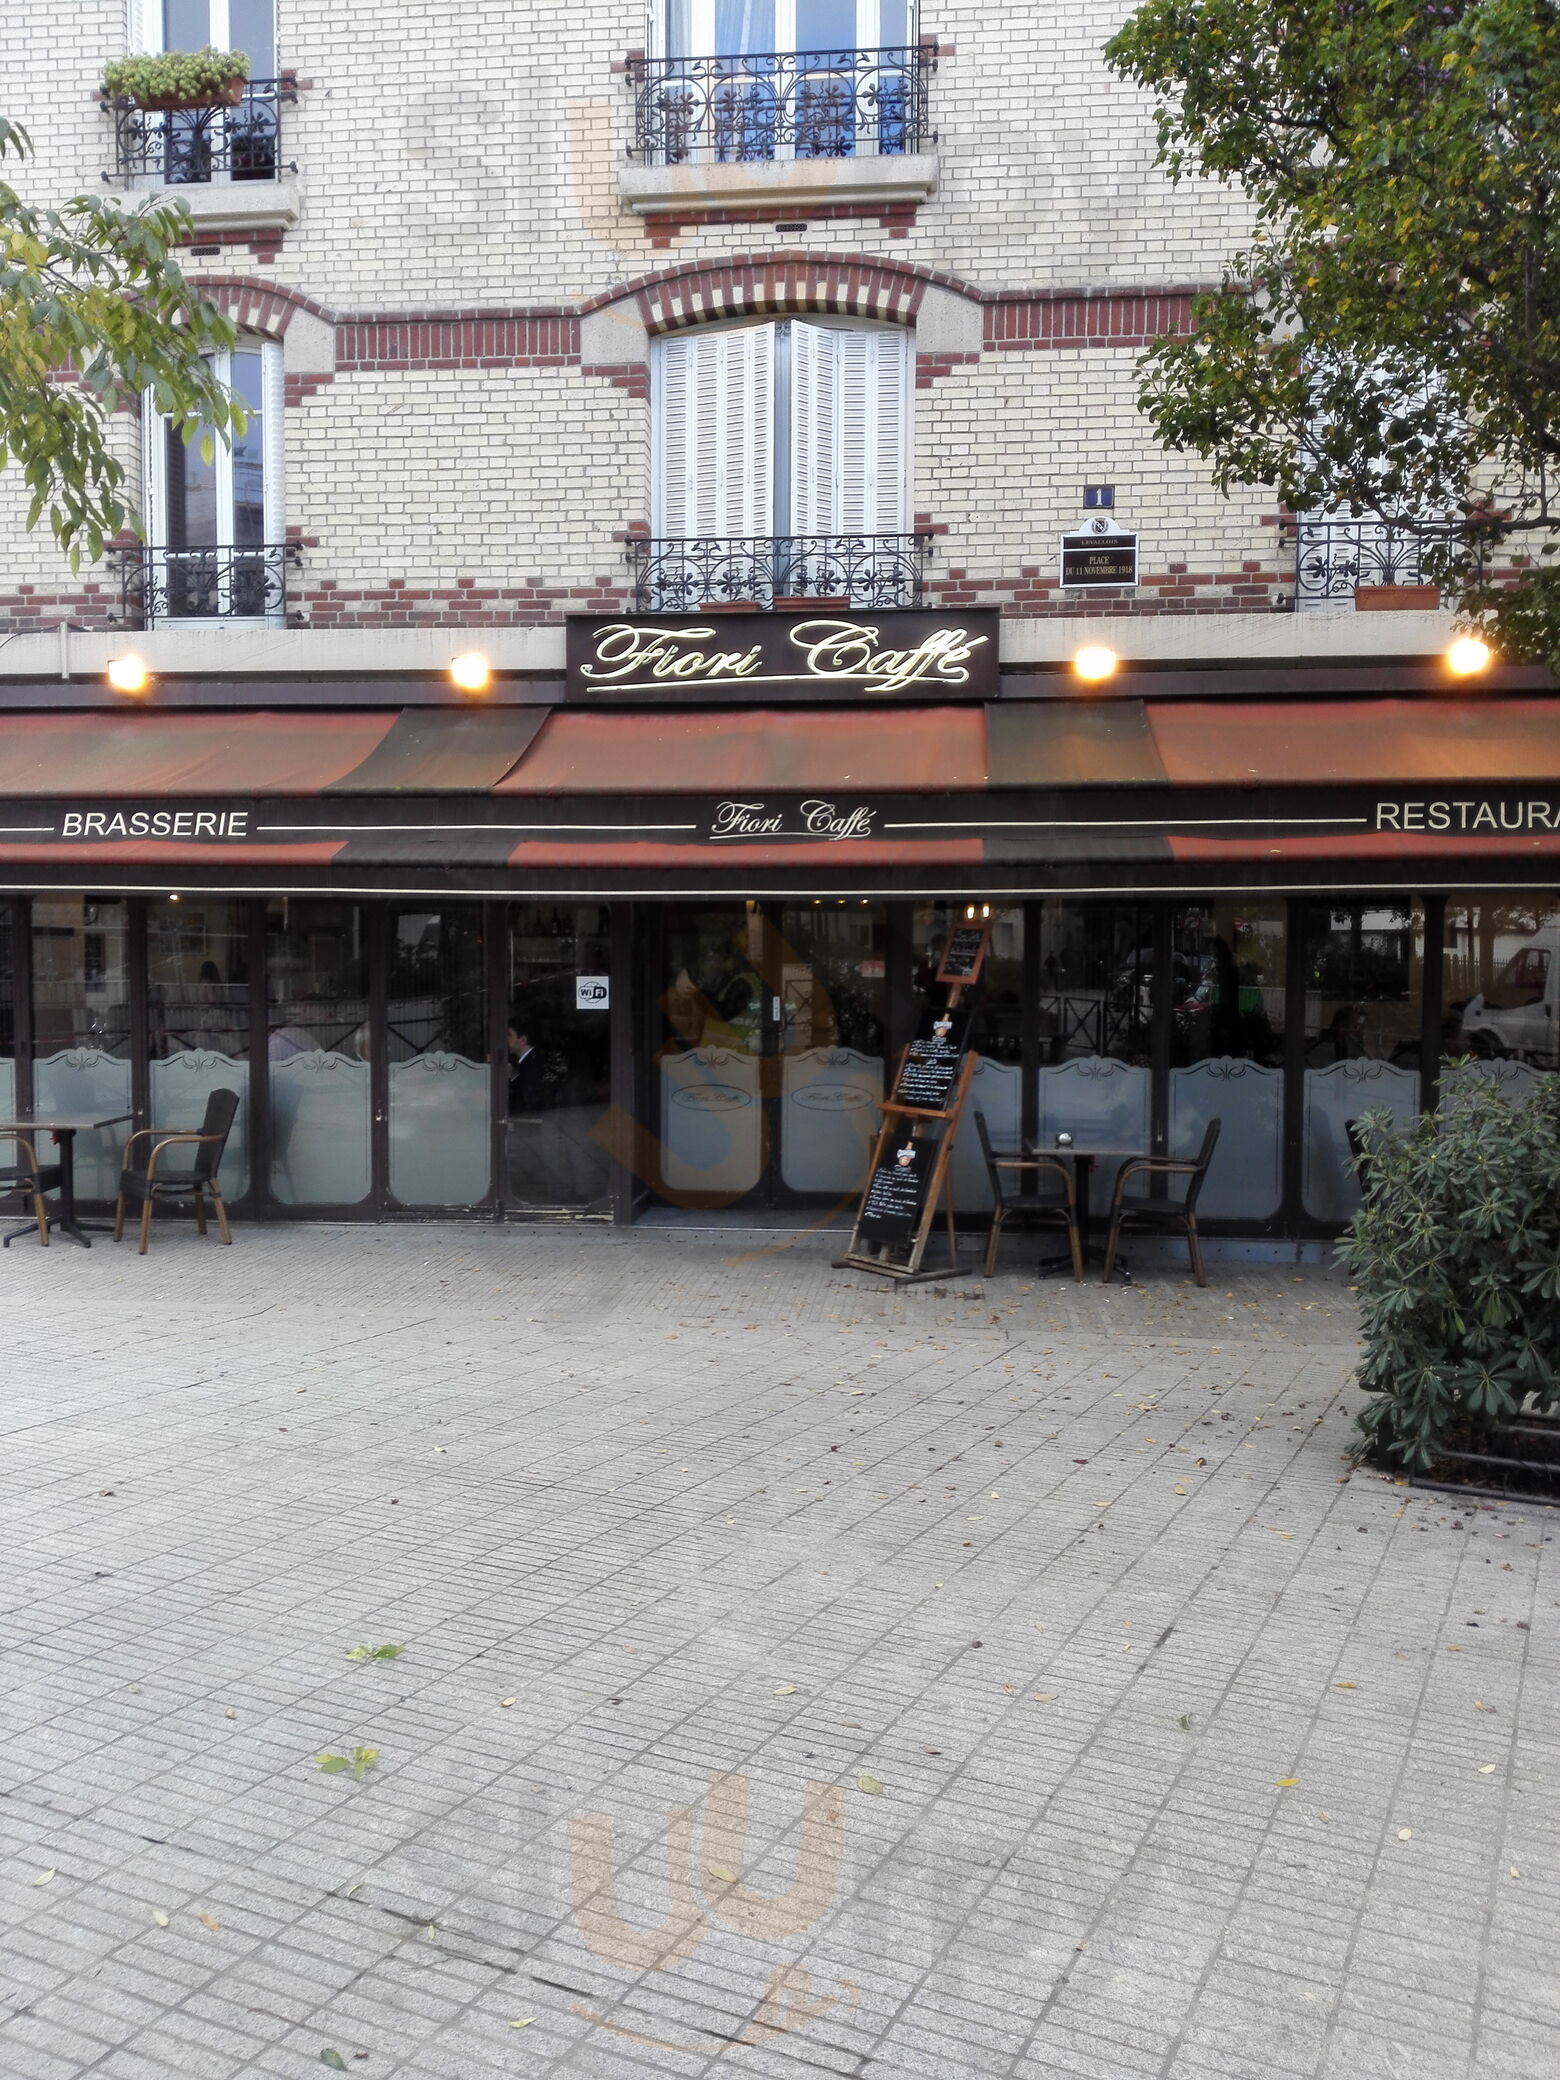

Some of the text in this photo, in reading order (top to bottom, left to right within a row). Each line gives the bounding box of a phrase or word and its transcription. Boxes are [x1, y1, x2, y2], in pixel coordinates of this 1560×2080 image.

[1096, 488, 1103, 506] 1
[1065, 565, 1133, 576] DU 11 NOVEMBRE 1918
[1089, 556, 1110, 565] PLACE
[580, 619, 989, 691] Fiori Caffé
[62, 812, 248, 836] BRASSERIE
[711, 800, 877, 840] Fiori Caffé
[1376, 801, 1560, 829] RESTAUR
